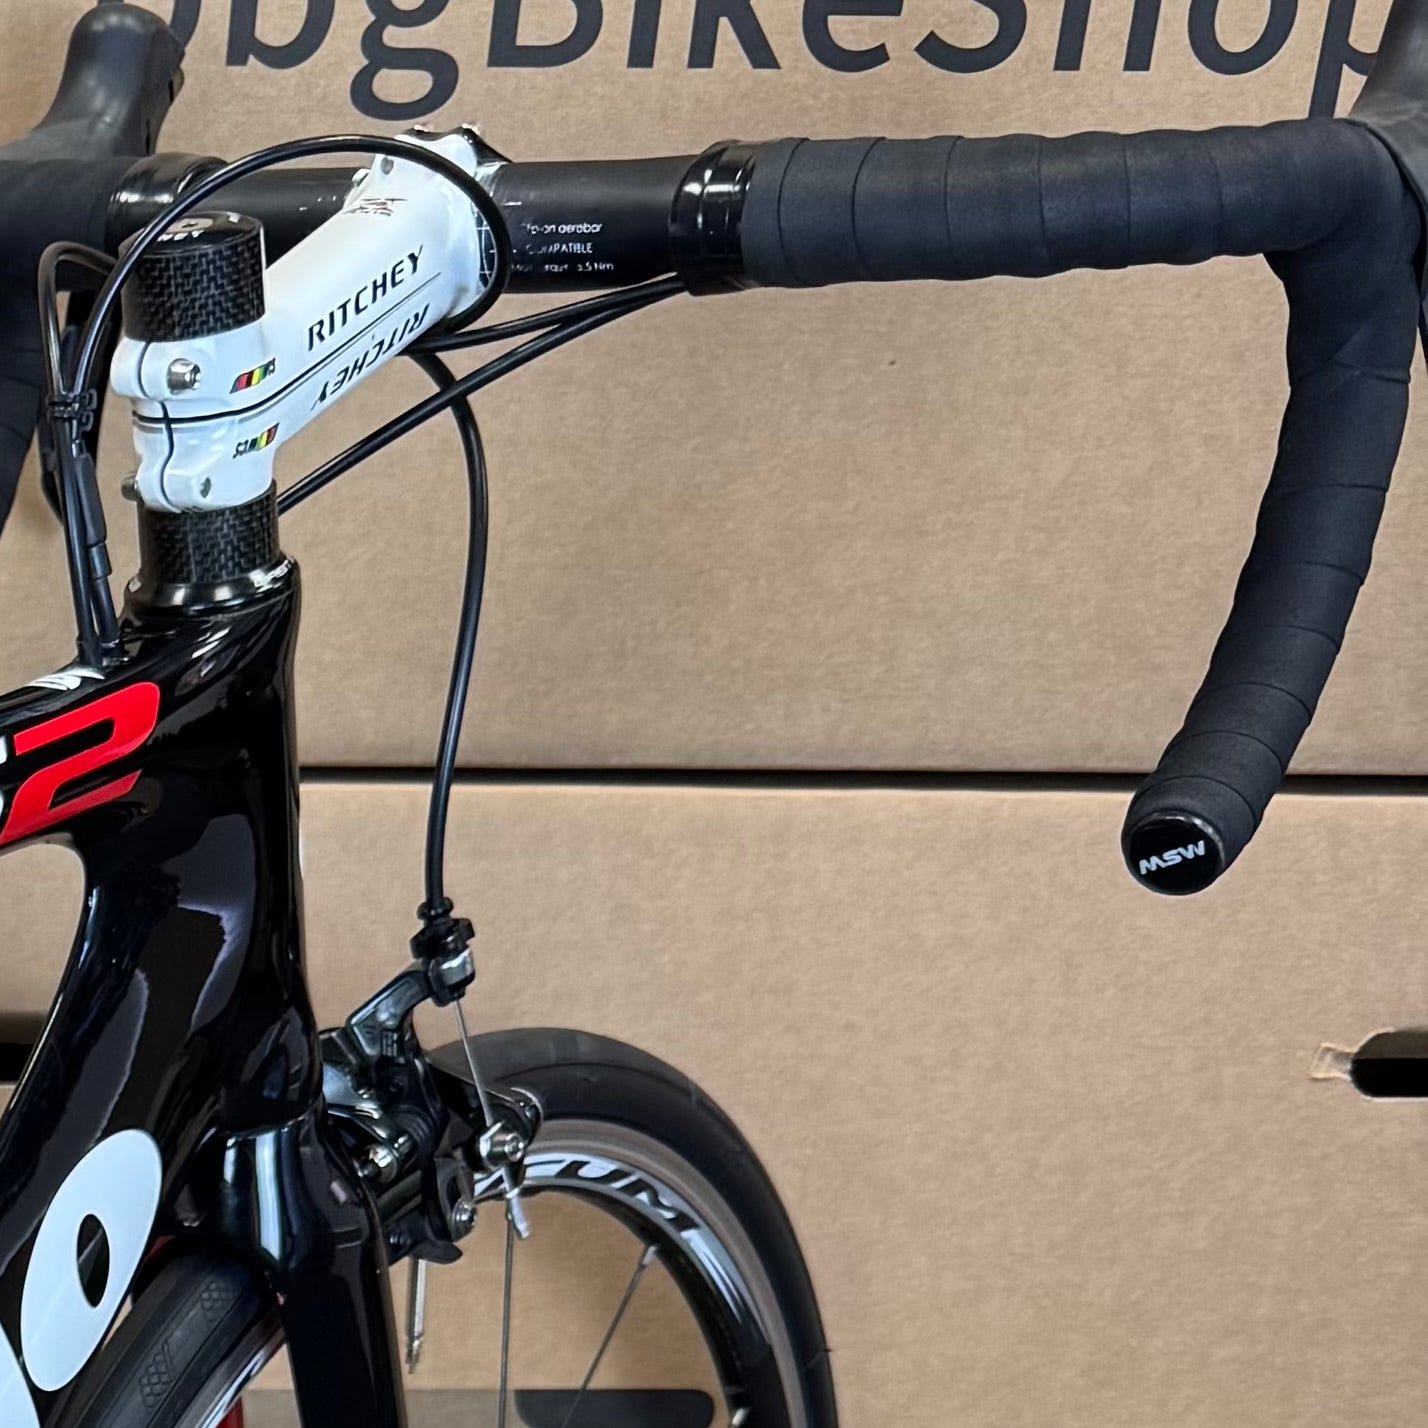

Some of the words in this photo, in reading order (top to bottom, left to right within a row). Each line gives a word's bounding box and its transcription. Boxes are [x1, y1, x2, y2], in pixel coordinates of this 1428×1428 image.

[307, 244, 424, 352] RITCHEY
[310, 302, 431, 411] RITCHEY
[1138, 839, 1206, 876] MSW
